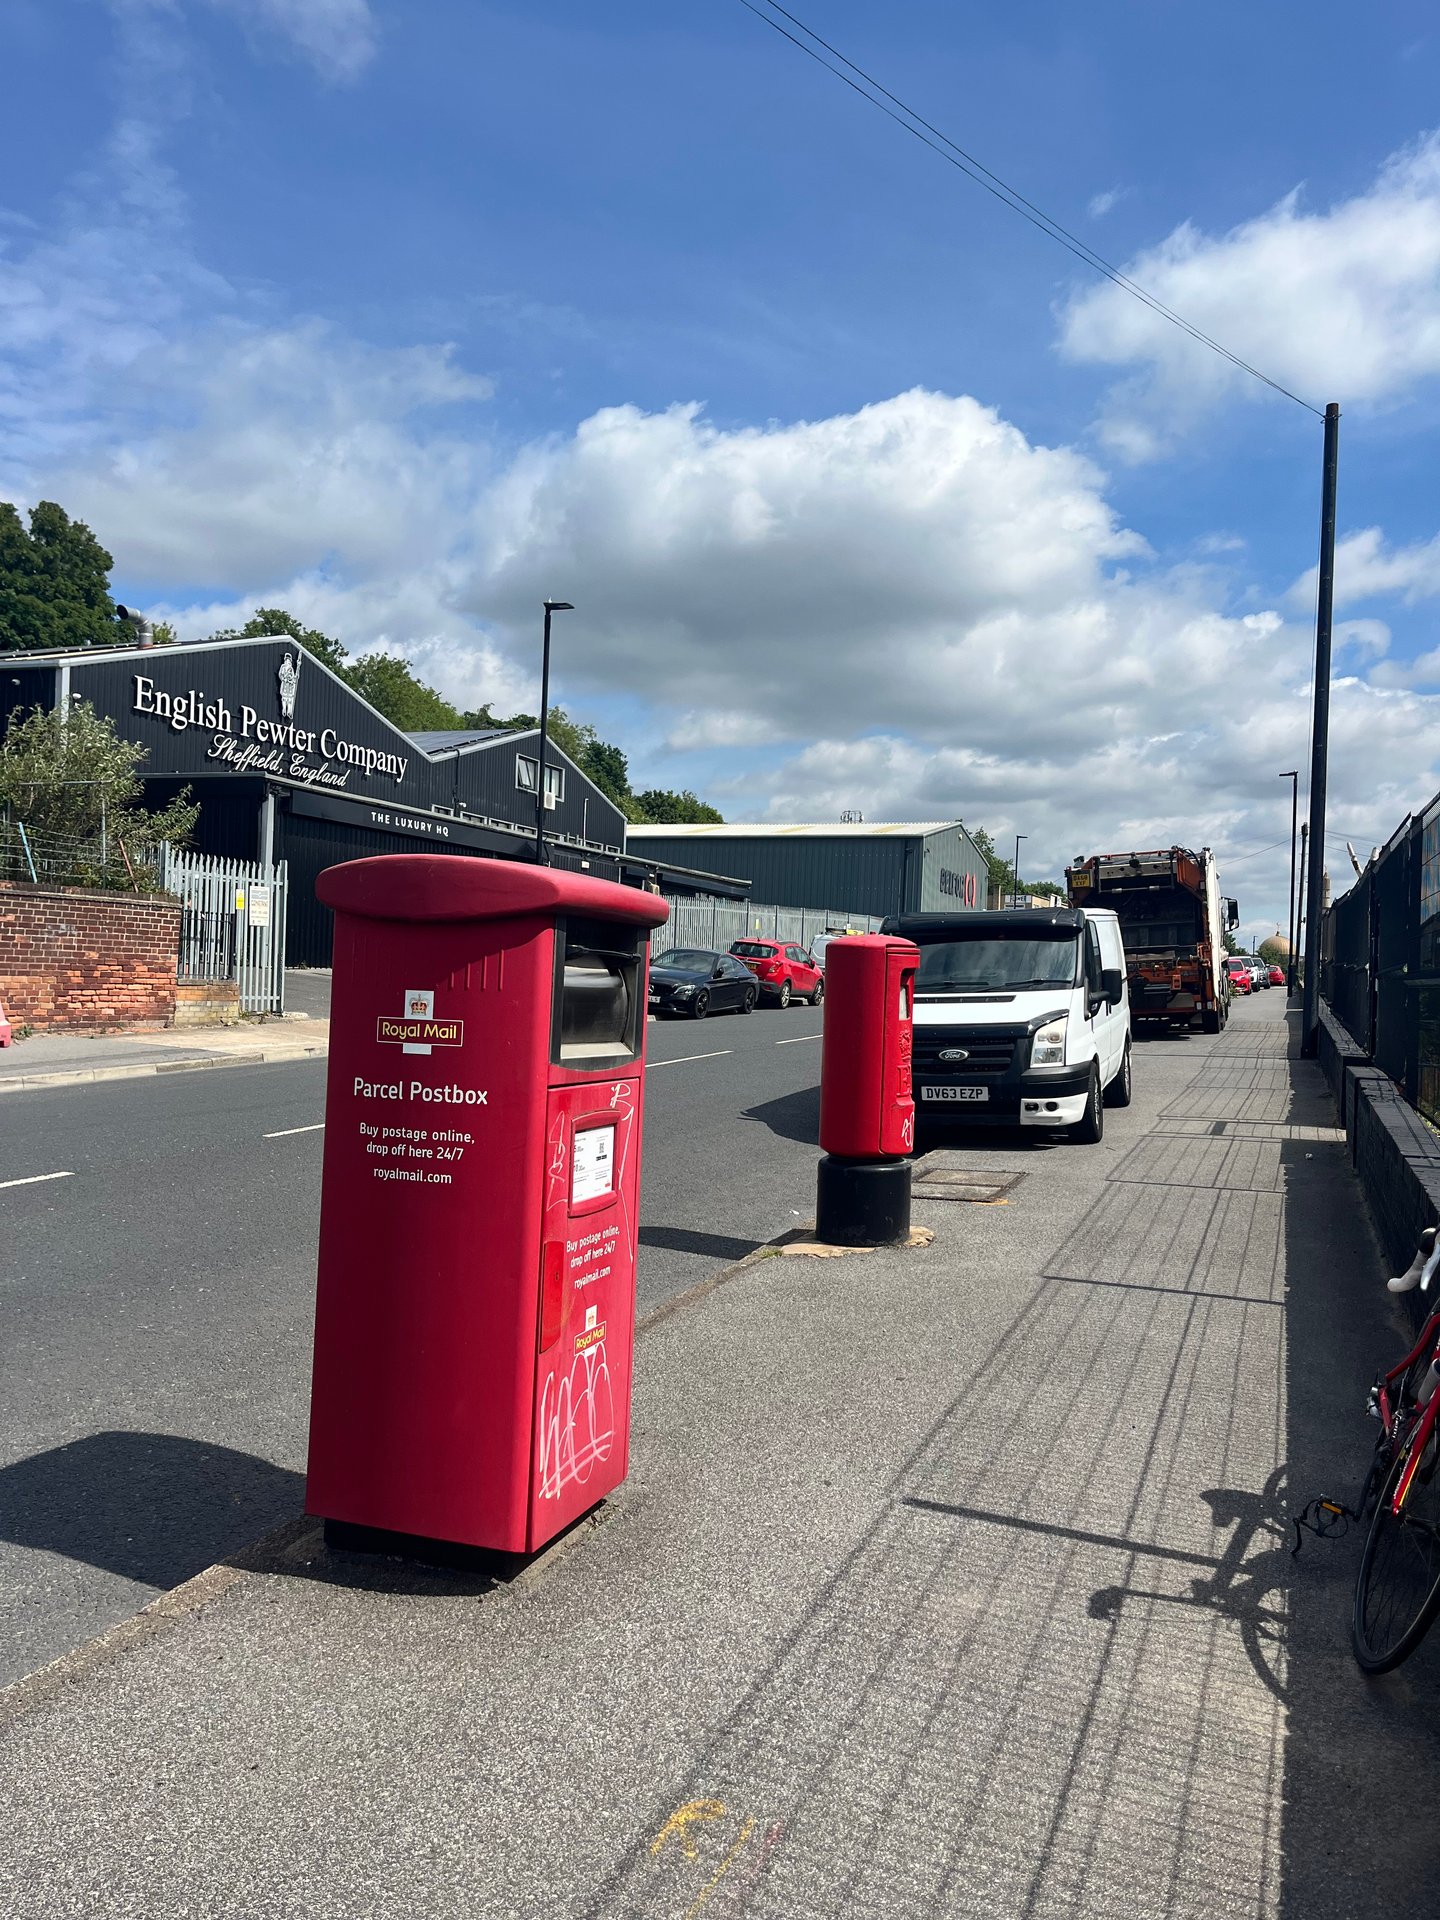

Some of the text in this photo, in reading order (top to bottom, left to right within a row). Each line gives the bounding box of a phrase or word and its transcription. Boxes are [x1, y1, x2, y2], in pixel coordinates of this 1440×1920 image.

[133, 674, 409, 783] English Pewter Company
[207, 733, 351, 788] Sheffield, England
[371, 811, 449, 837] THE LUXURY HQ
[382, 1021, 457, 1040] Royal Mail
[944, 1051, 961, 1059] Ford
[353, 1077, 488, 1105] Parcel Postbox
[926, 1088, 983, 1099] DV63 EZP
[359, 1122, 475, 1144] Buy postage online,
[366, 1141, 464, 1160] drop off here 24/7
[373, 1166, 452, 1184] royalmail.com
[566, 1240, 578, 1253] Buy
[579, 1231, 601, 1250] postage
[570, 1240, 616, 1268] drop off here 24/7
[574, 1265, 611, 1290] royalmail.com
[575, 1325, 605, 1350] Royal Mail
